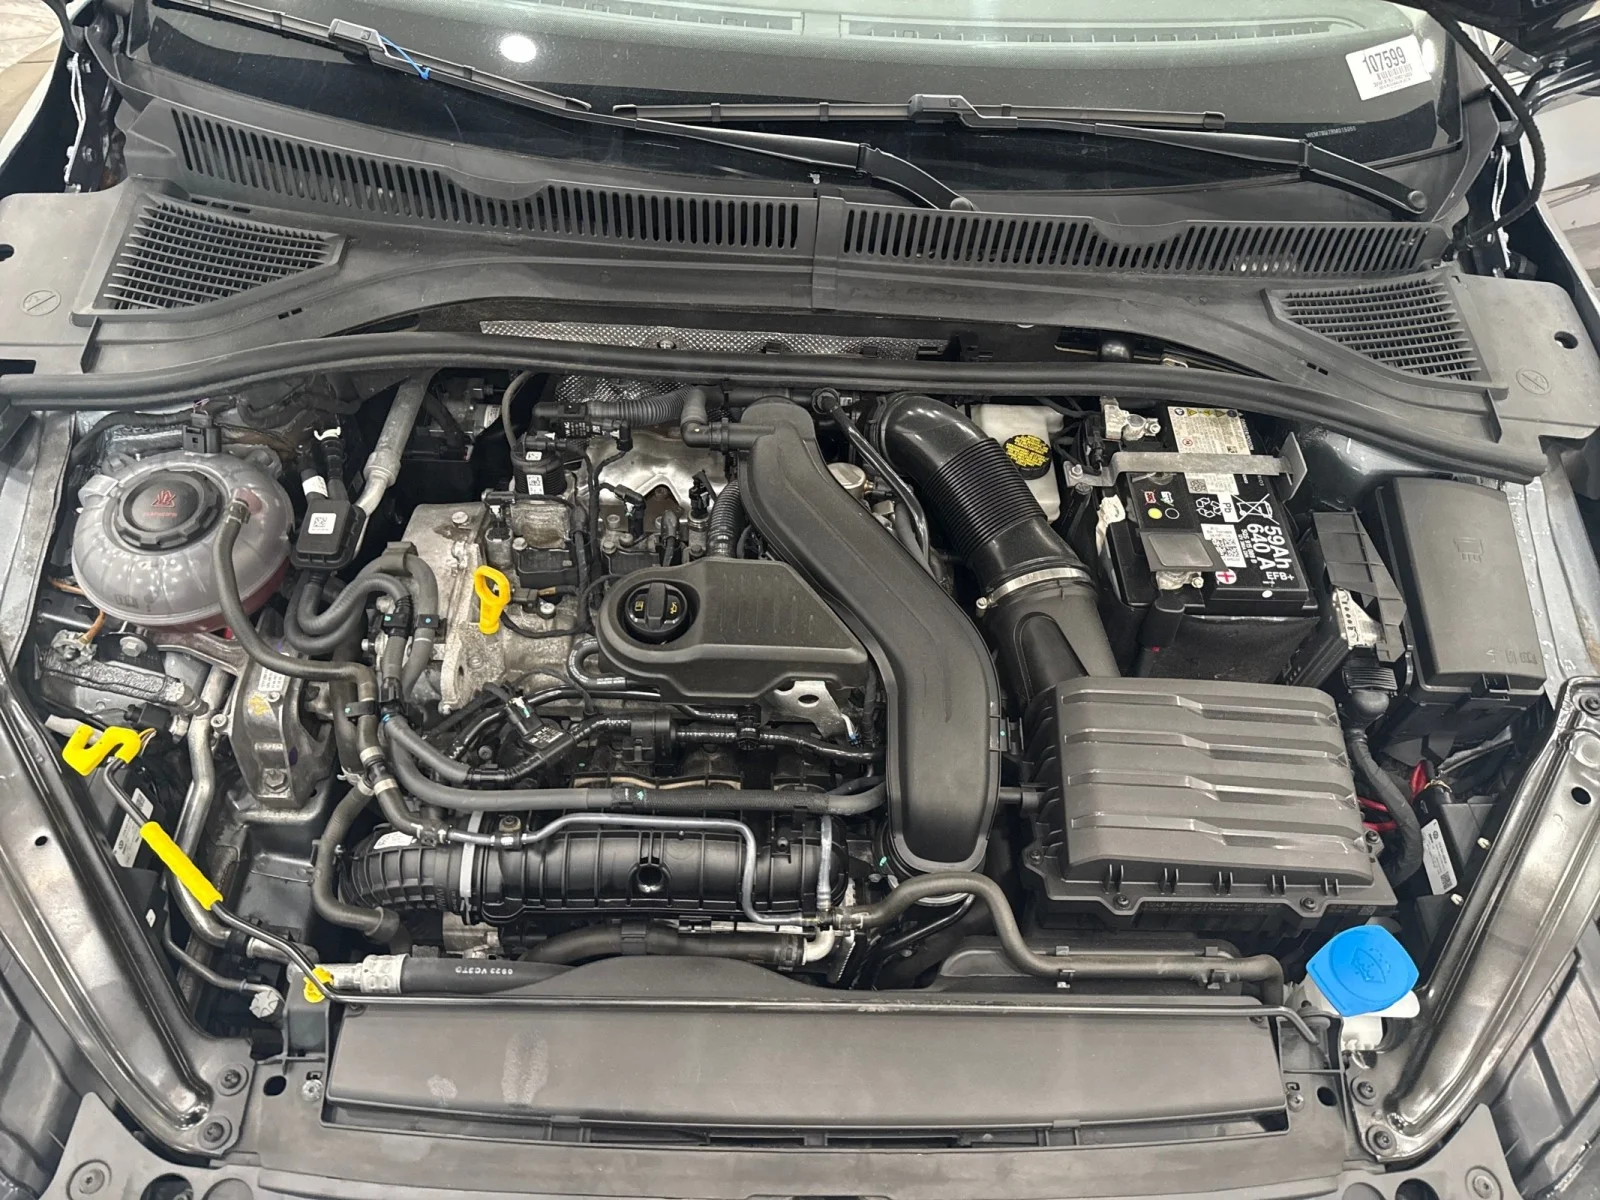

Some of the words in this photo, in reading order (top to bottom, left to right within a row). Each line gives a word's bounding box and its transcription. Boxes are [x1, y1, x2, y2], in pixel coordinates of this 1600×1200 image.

[1362, 46, 1406, 74] 107599
[1223, 502, 1231, 513] Pb
[1246, 523, 1270, 553] 640
[1264, 525, 1292, 569] 59Ah
[1256, 556, 1276, 570] A
[1265, 571, 1294, 581] EFB+
